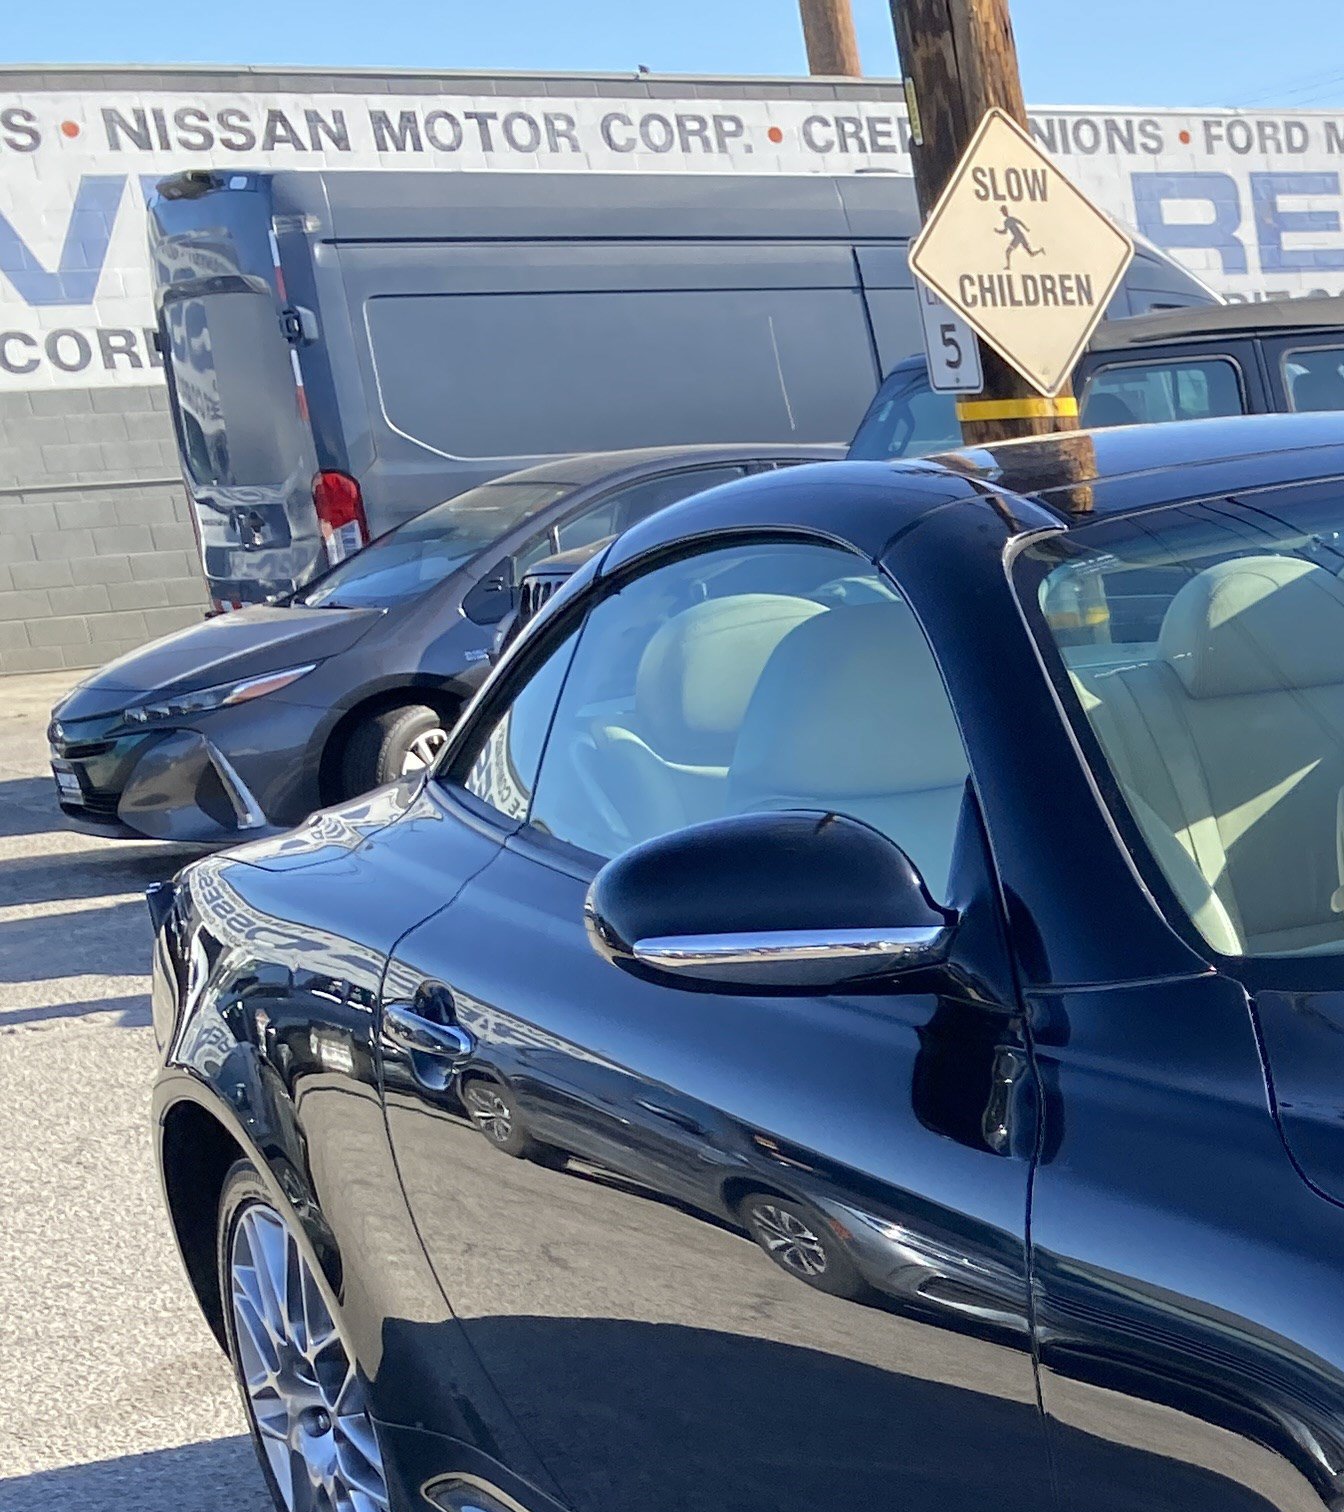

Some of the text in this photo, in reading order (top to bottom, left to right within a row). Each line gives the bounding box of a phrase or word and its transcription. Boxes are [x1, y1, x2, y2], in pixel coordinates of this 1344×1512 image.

[1, 108, 42, 152] S
[101, 107, 753, 154] NISSAN MOTOR CORP.
[1029, 117, 1164, 155] NIONS
[1204, 119, 1310, 155] FORD
[972, 166, 1049, 203] SLOW
[959, 273, 1095, 308] CHILDREN
[940, 323, 962, 370] 5
